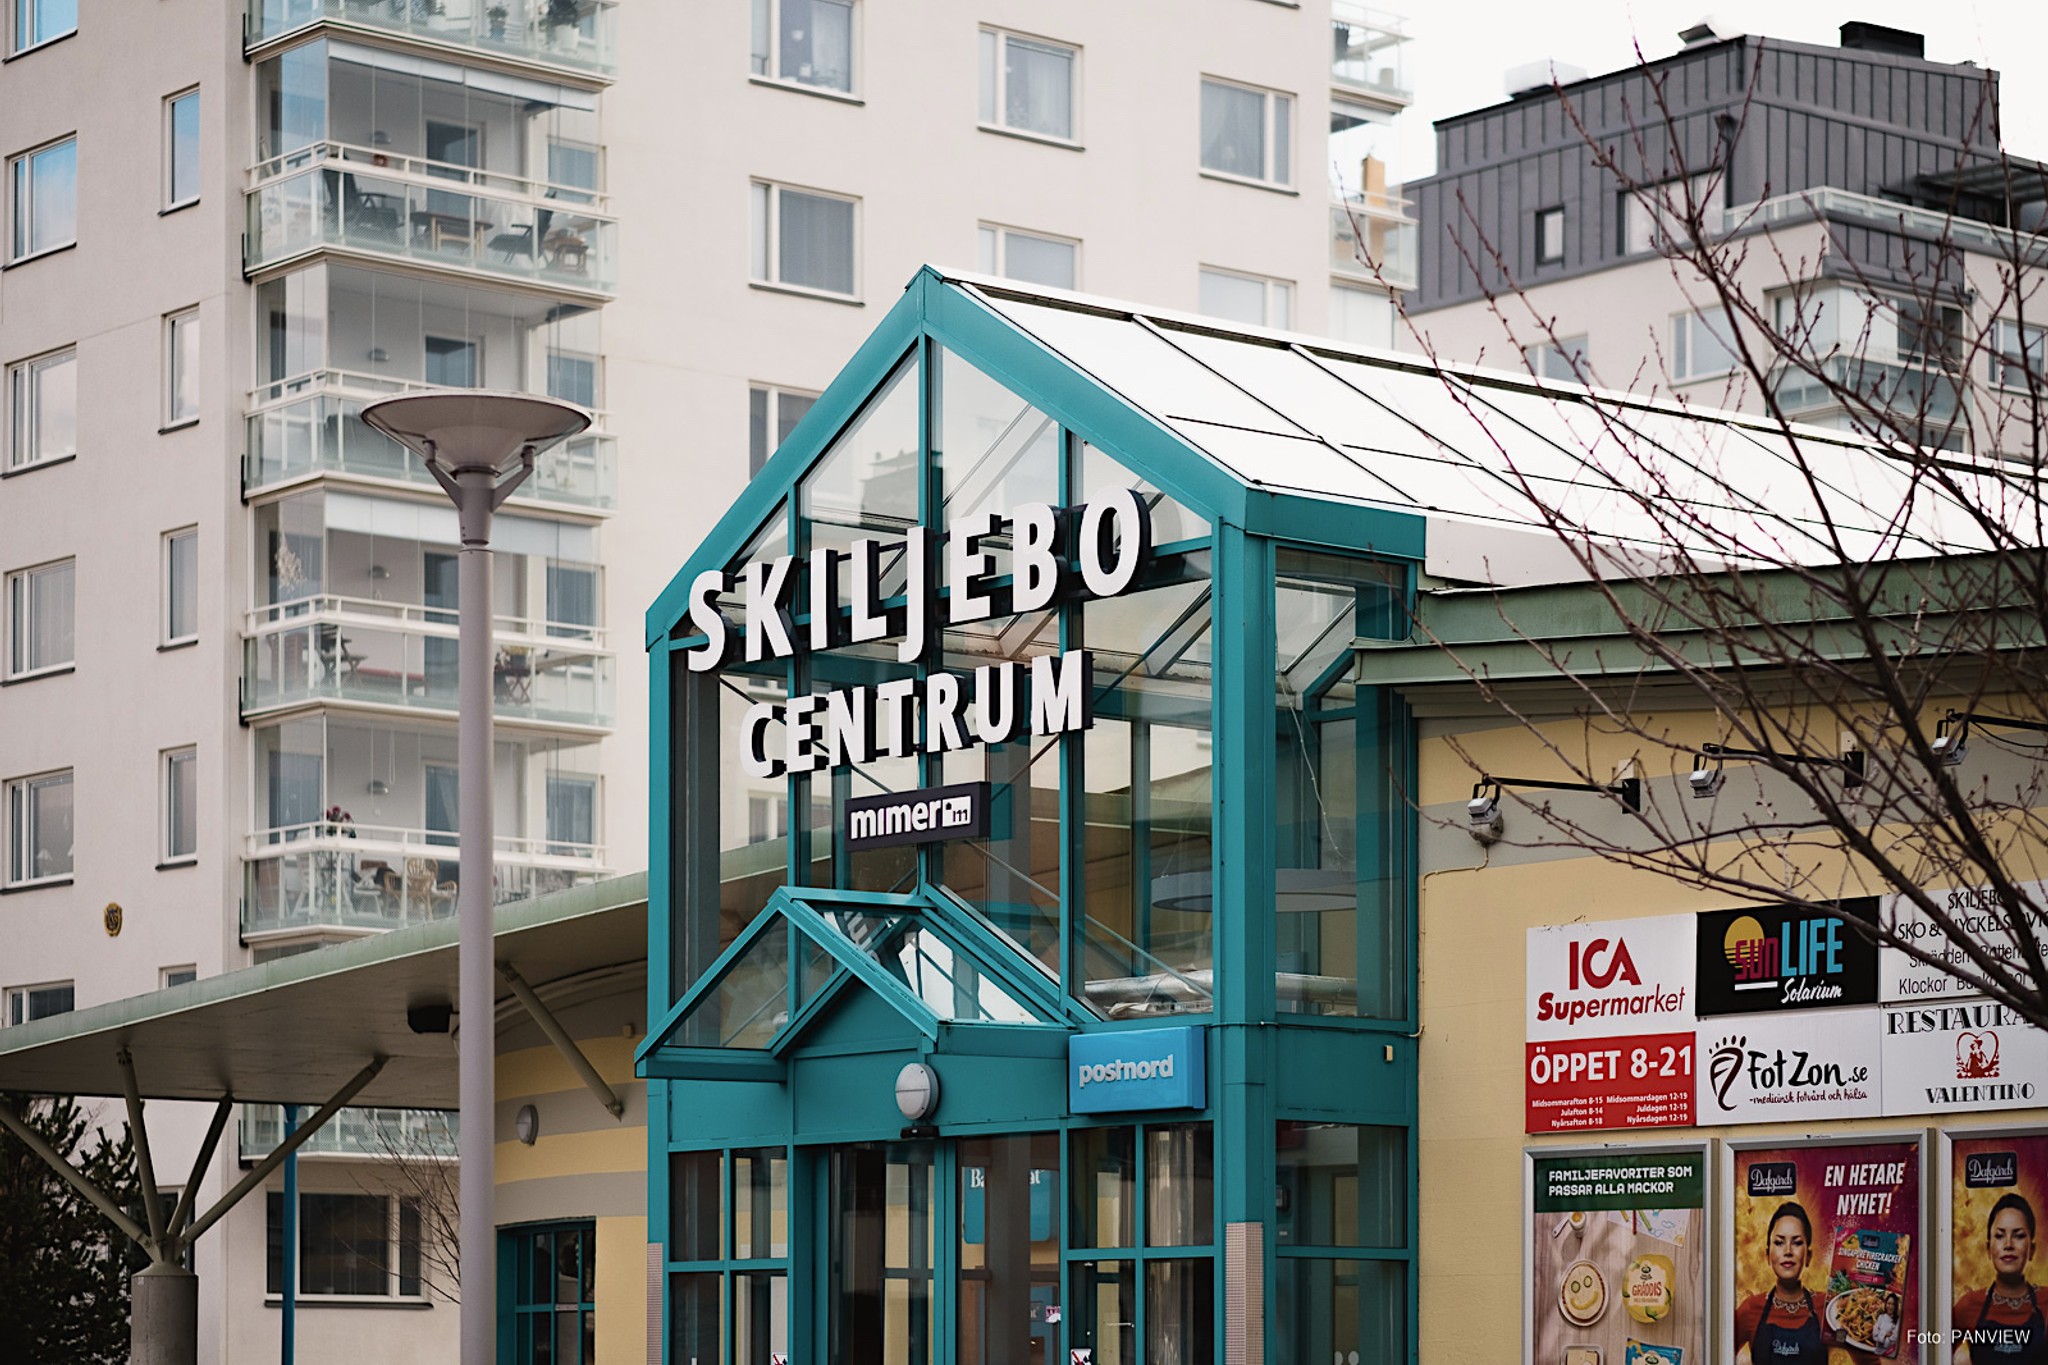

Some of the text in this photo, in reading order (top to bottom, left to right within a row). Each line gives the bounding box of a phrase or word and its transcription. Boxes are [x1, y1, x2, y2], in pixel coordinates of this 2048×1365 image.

[688, 486, 1148, 673] SKILJEBO
[740, 650, 1090, 778] CENTRUM
[851, 799, 941, 839] mimer
[1898, 921, 1926, 939] SKO
[1929, 924, 1942, 937] &
[1781, 917, 1844, 977] LIFE
[1569, 936, 1642, 990] ICA
[1781, 977, 1843, 1004] Solarium
[1899, 976, 1948, 995] Klockor
[1537, 983, 1686, 1025] Supermarket
[1887, 1003, 2035, 1035] RESTAURA
[1079, 1054, 1174, 1088] postnord
[1530, 1045, 1691, 1084] ÖPPET 8-21
[1606, 1093, 1668, 1103] Midsommardagen
[1828, 1089, 1842, 1100] och
[1925, 1082, 2035, 1103] VALENTINO
[1626, 1114, 1668, 1125] Nyårsdagen
[1636, 1103, 1668, 1113] Juldagen
[1549, 1166, 1693, 1182] FAMILJEFAVORITER SOM
[1824, 1162, 1906, 1187] EN HETARE
[1549, 1181, 1674, 1196] PASSAR ALLA MACKOR
[1836, 1192, 1893, 1216] NYHET!
